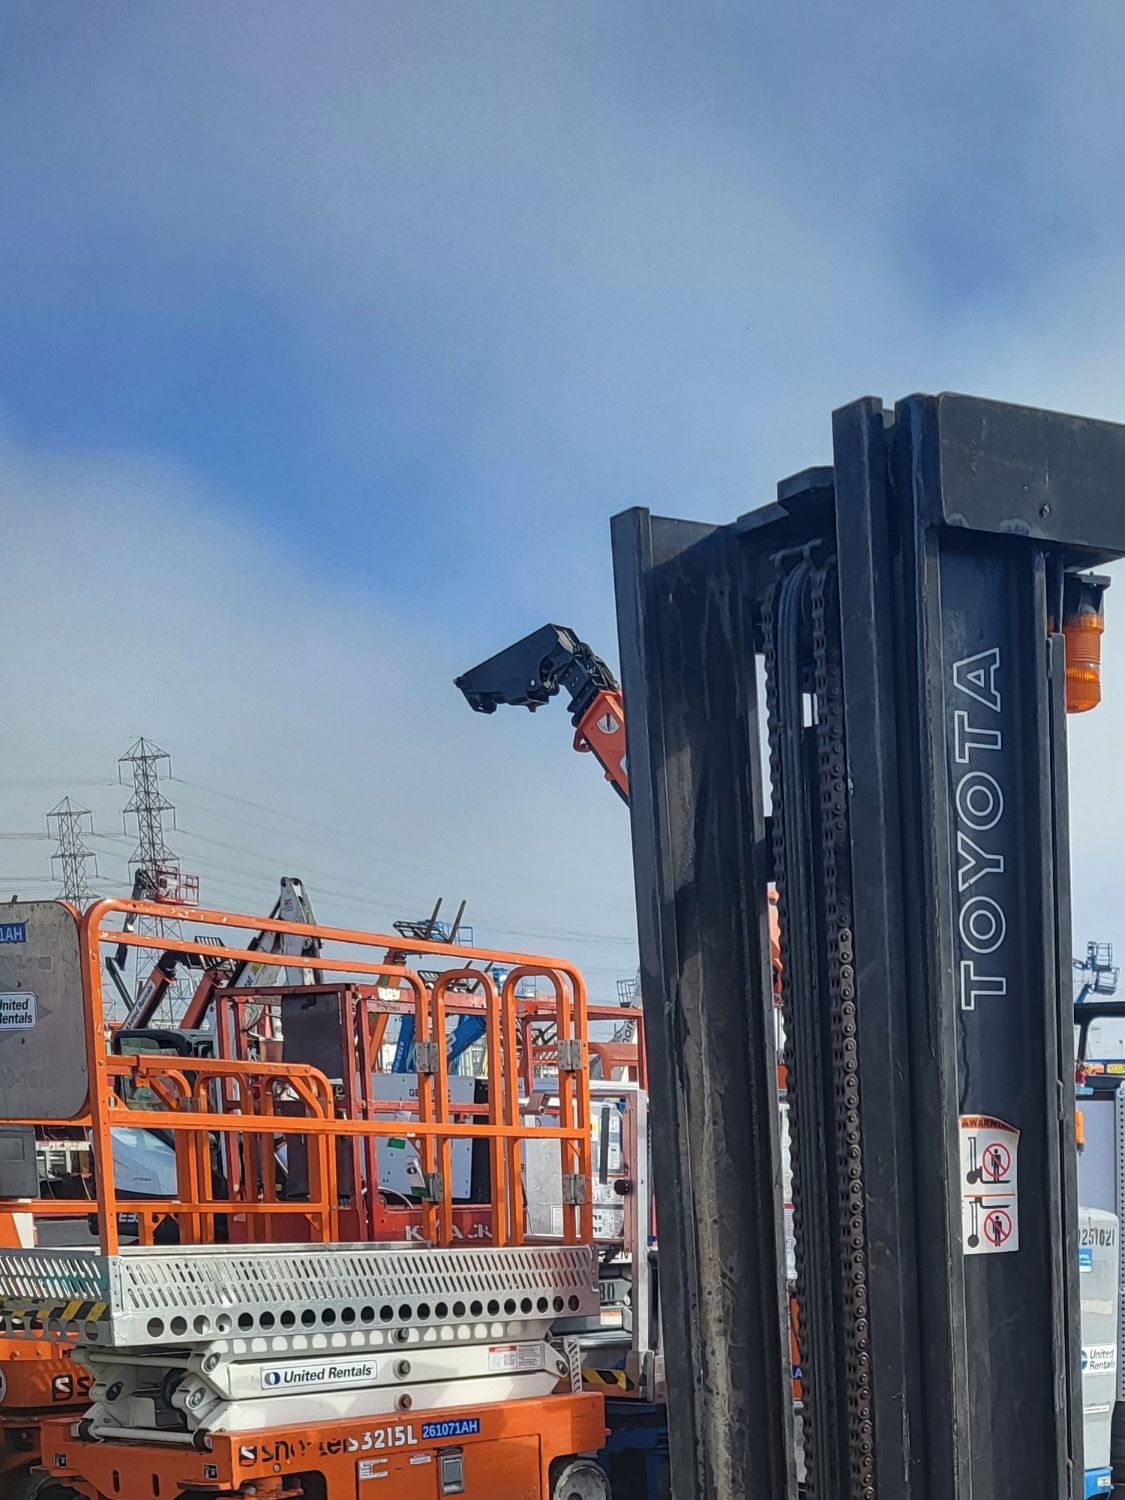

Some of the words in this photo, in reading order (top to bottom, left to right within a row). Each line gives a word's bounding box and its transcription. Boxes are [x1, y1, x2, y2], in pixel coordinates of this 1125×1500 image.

[953, 647, 1007, 1011] TOYOTA
[0, 1012, 33, 1024] entals
[1089, 1349, 1114, 1360] United
[1089, 1358, 1115, 1370] Rentals
[283, 1368, 326, 1384] United
[328, 1364, 373, 1380] Rentals
[422, 1420, 479, 1438] 261071AH
